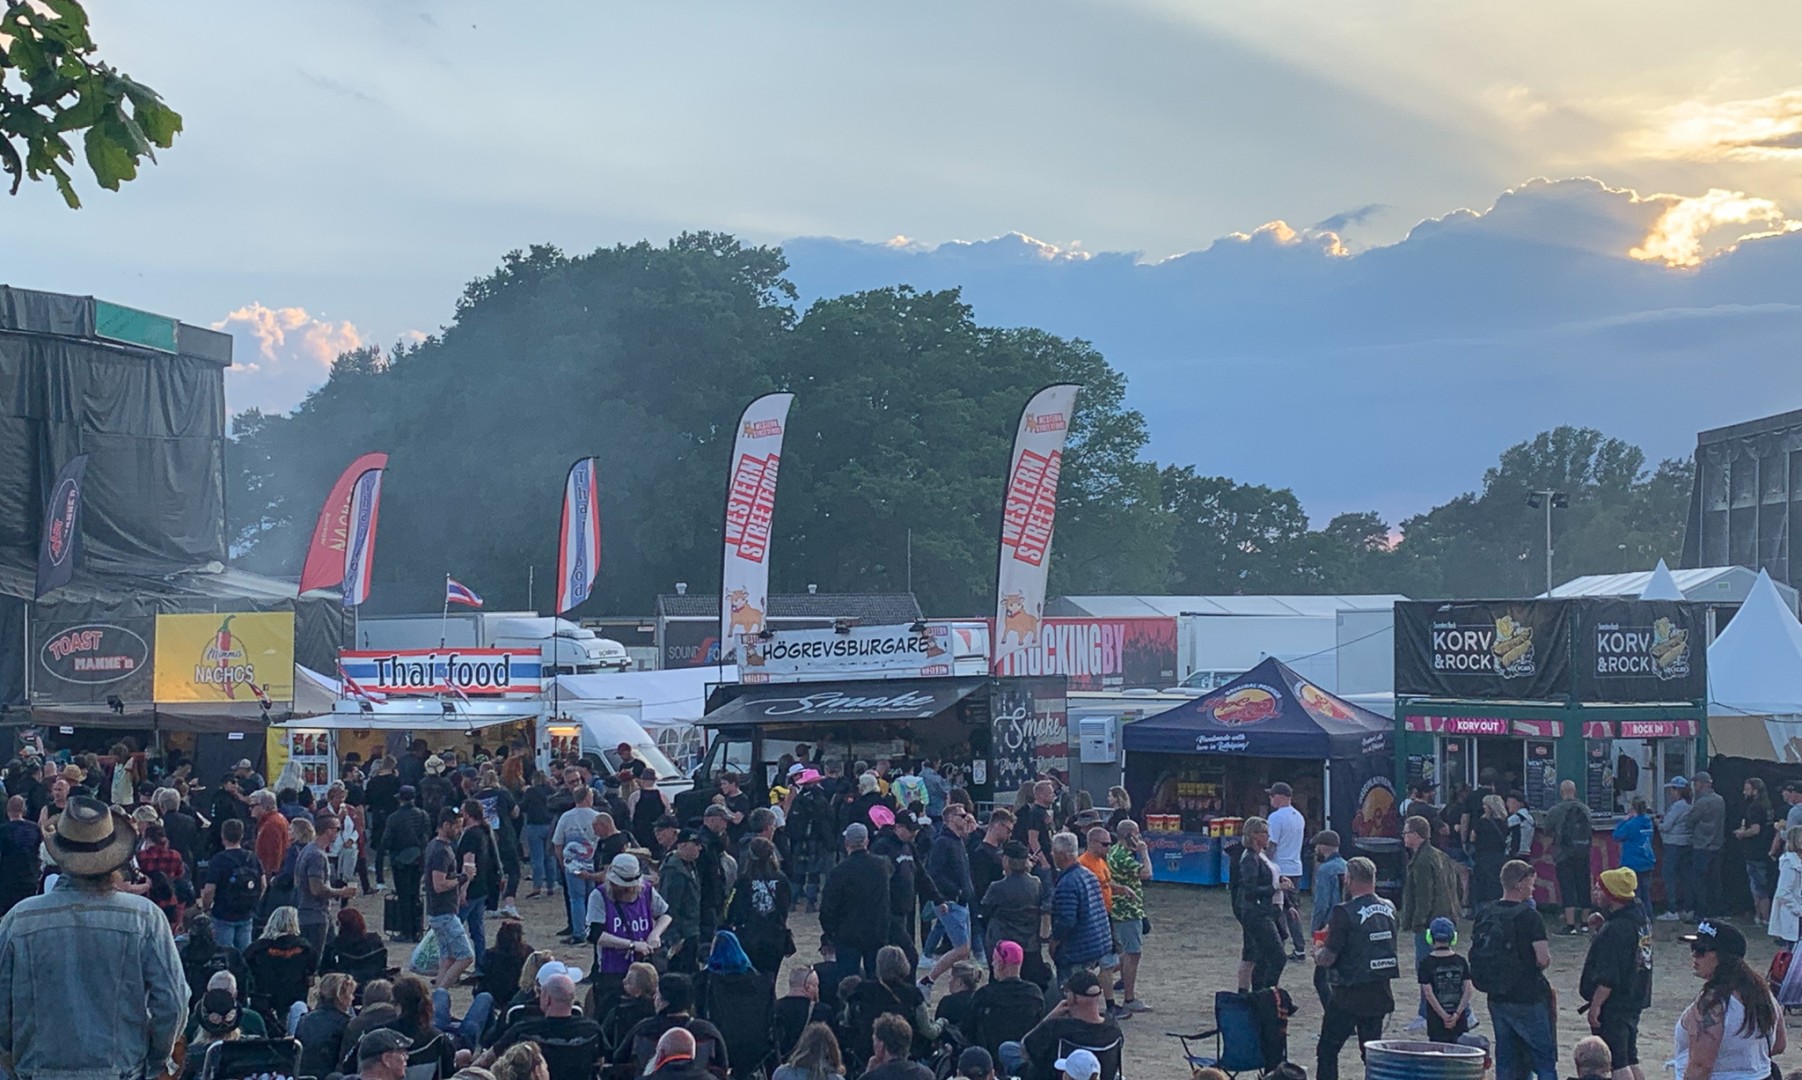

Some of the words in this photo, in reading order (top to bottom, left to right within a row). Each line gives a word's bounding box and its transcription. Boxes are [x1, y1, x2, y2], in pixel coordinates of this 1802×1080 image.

[726, 458, 763, 541] WESTERN
[740, 458, 780, 558] STREETFOOD
[1002, 455, 1048, 543] WESTERN
[1017, 455, 1061, 561] STREETFOOD
[49, 630, 103, 661] TOAST
[763, 635, 930, 661] HÖGREVSBURGARE
[1433, 631, 1491, 651] KORV
[1598, 632, 1650, 653] KORV
[195, 664, 255, 684] NACHOS
[374, 654, 436, 688] Thai
[449, 654, 511, 688] food
[1435, 654, 1491, 669] &ROCK
[1598, 656, 1649, 672] &ROCK
[746, 690, 935, 715] Smoke
[994, 707, 1062, 749] Smoke
[1457, 721, 1479, 731] KORV
[1480, 721, 1500, 731] OUT
[1632, 723, 1654, 734] ROCK
[1655, 722, 1664, 733] IN
